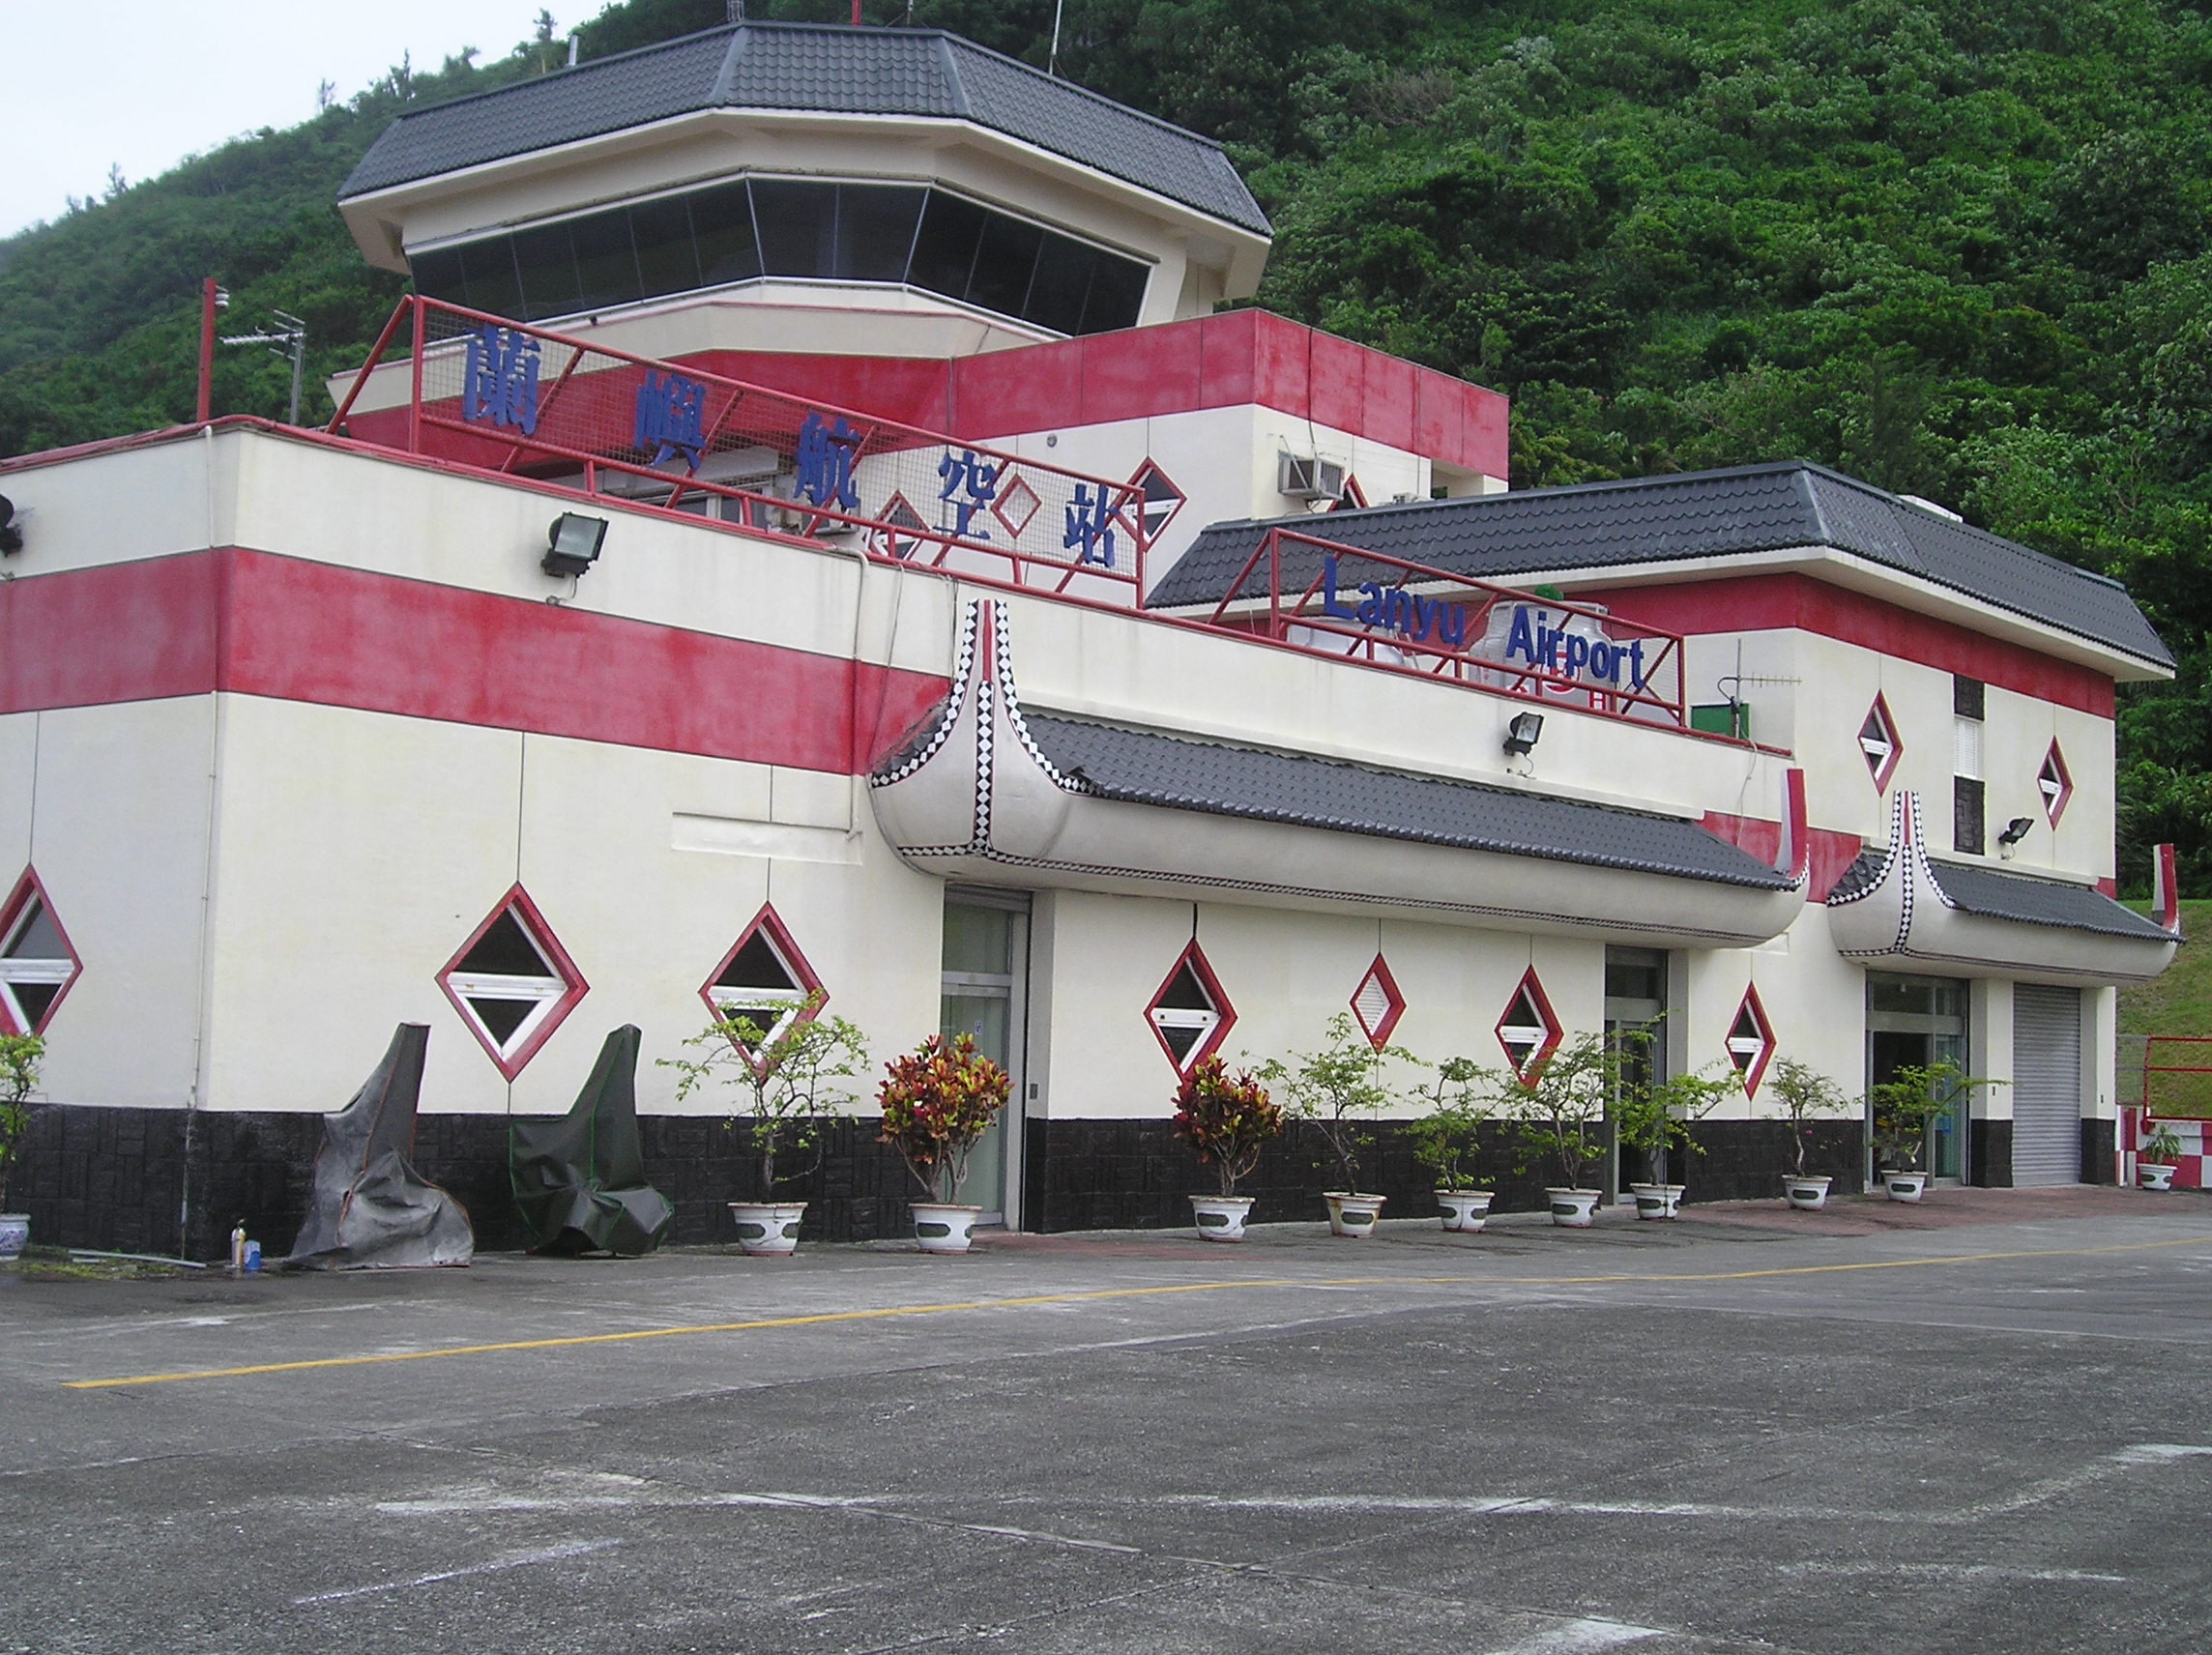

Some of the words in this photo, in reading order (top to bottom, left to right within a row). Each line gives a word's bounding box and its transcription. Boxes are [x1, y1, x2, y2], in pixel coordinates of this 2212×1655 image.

[463, 325, 1119, 568] 蘭嶼航空站
[1324, 556, 1465, 646] Lanyu
[1505, 605, 1644, 690] Airport
